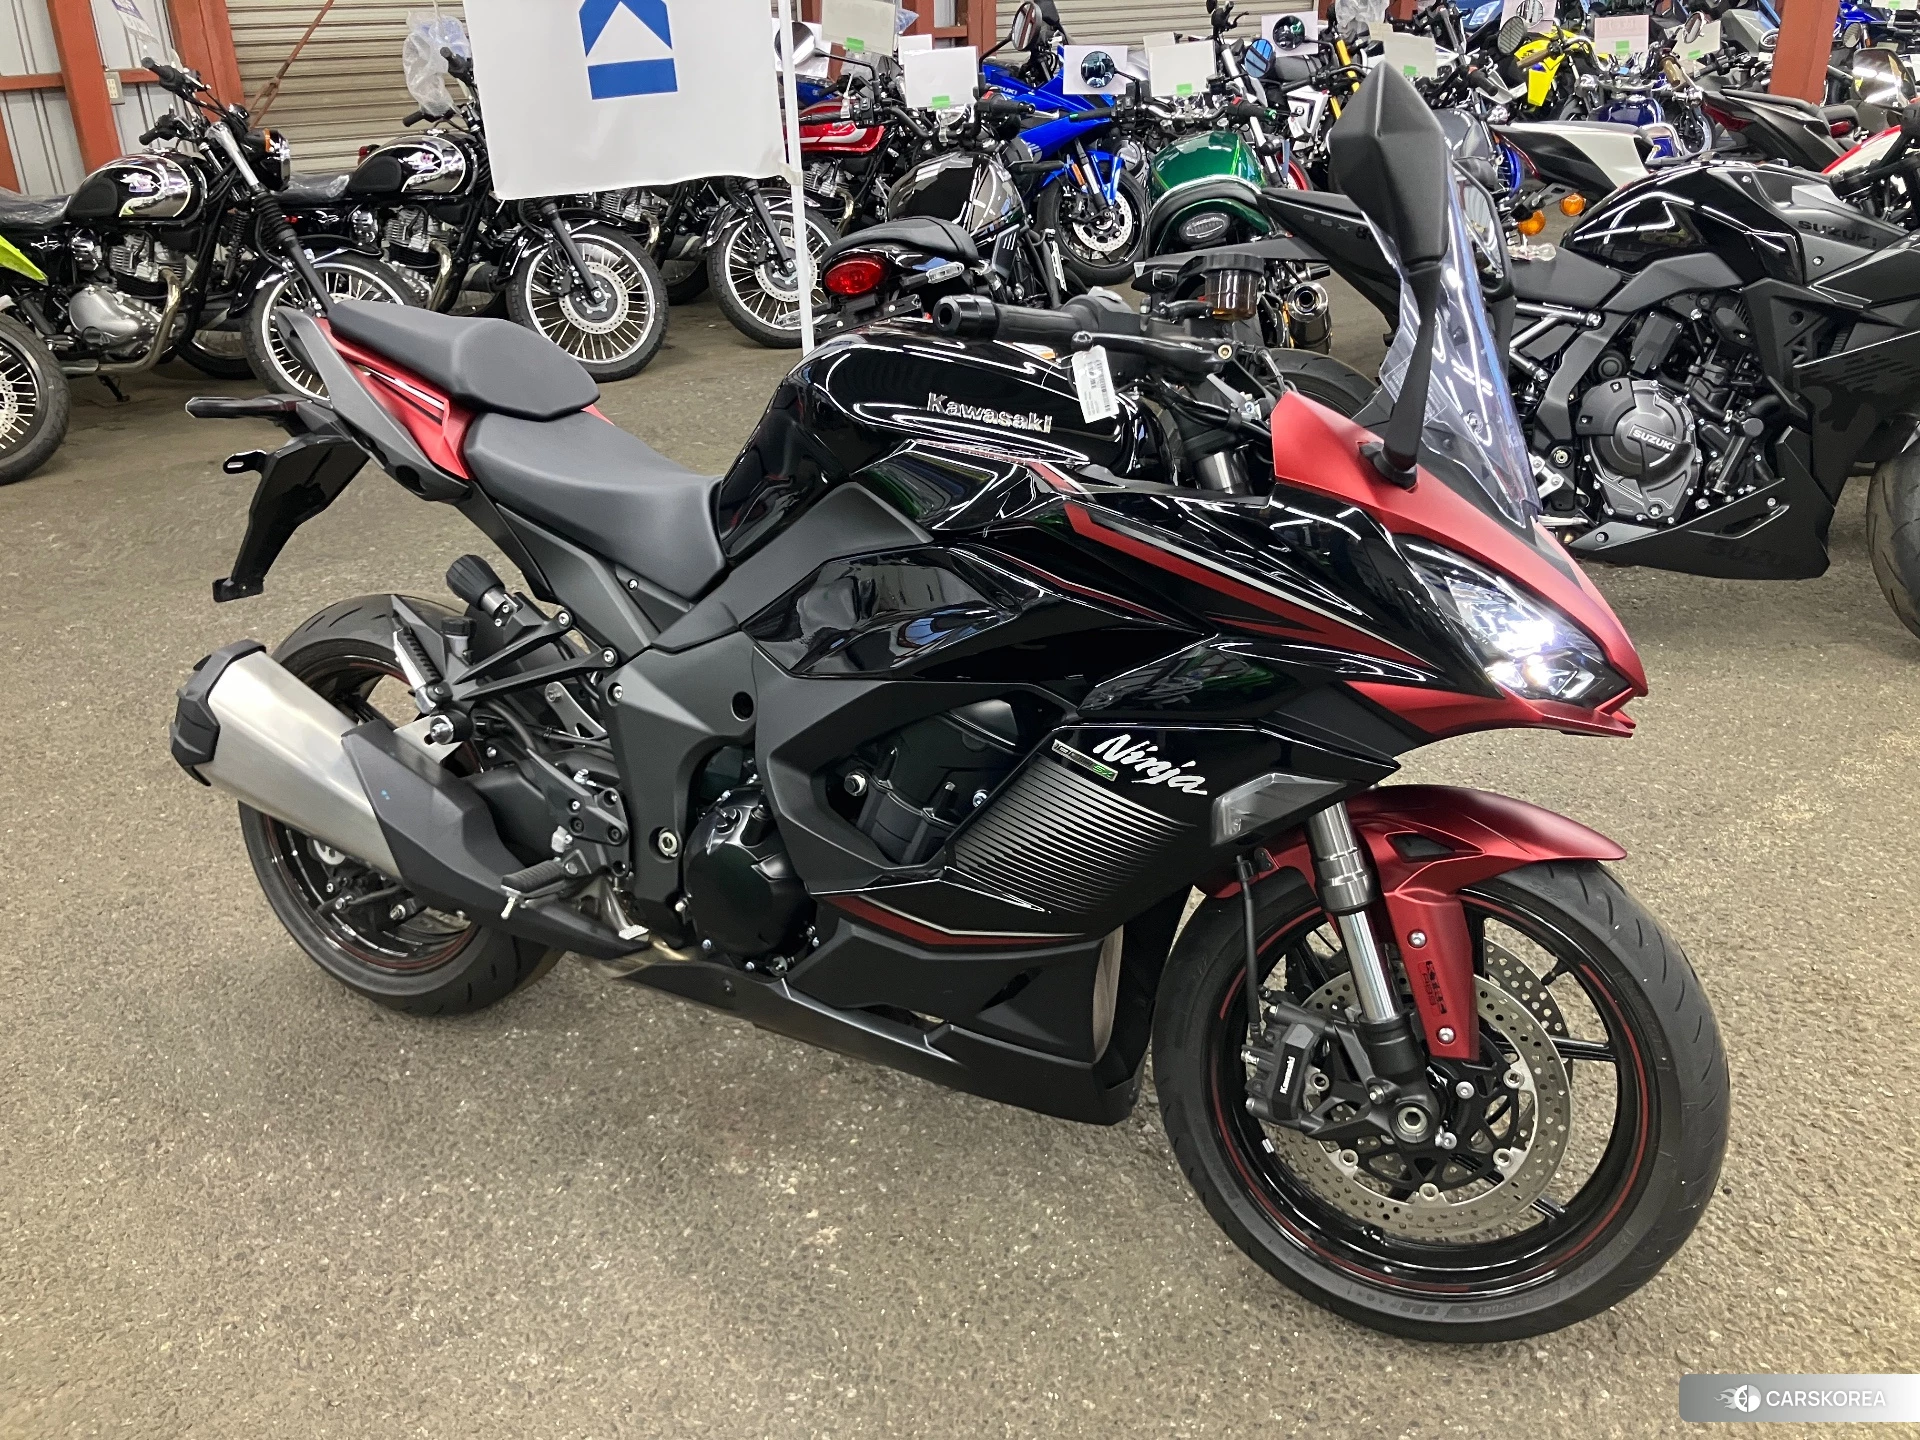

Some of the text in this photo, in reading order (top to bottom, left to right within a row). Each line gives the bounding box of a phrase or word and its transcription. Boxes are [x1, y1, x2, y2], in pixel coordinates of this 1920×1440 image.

[927, 392, 1053, 434] Kawasaki
[1632, 429, 1676, 452] SUZUKI
[1092, 734, 1208, 796] Ninja
